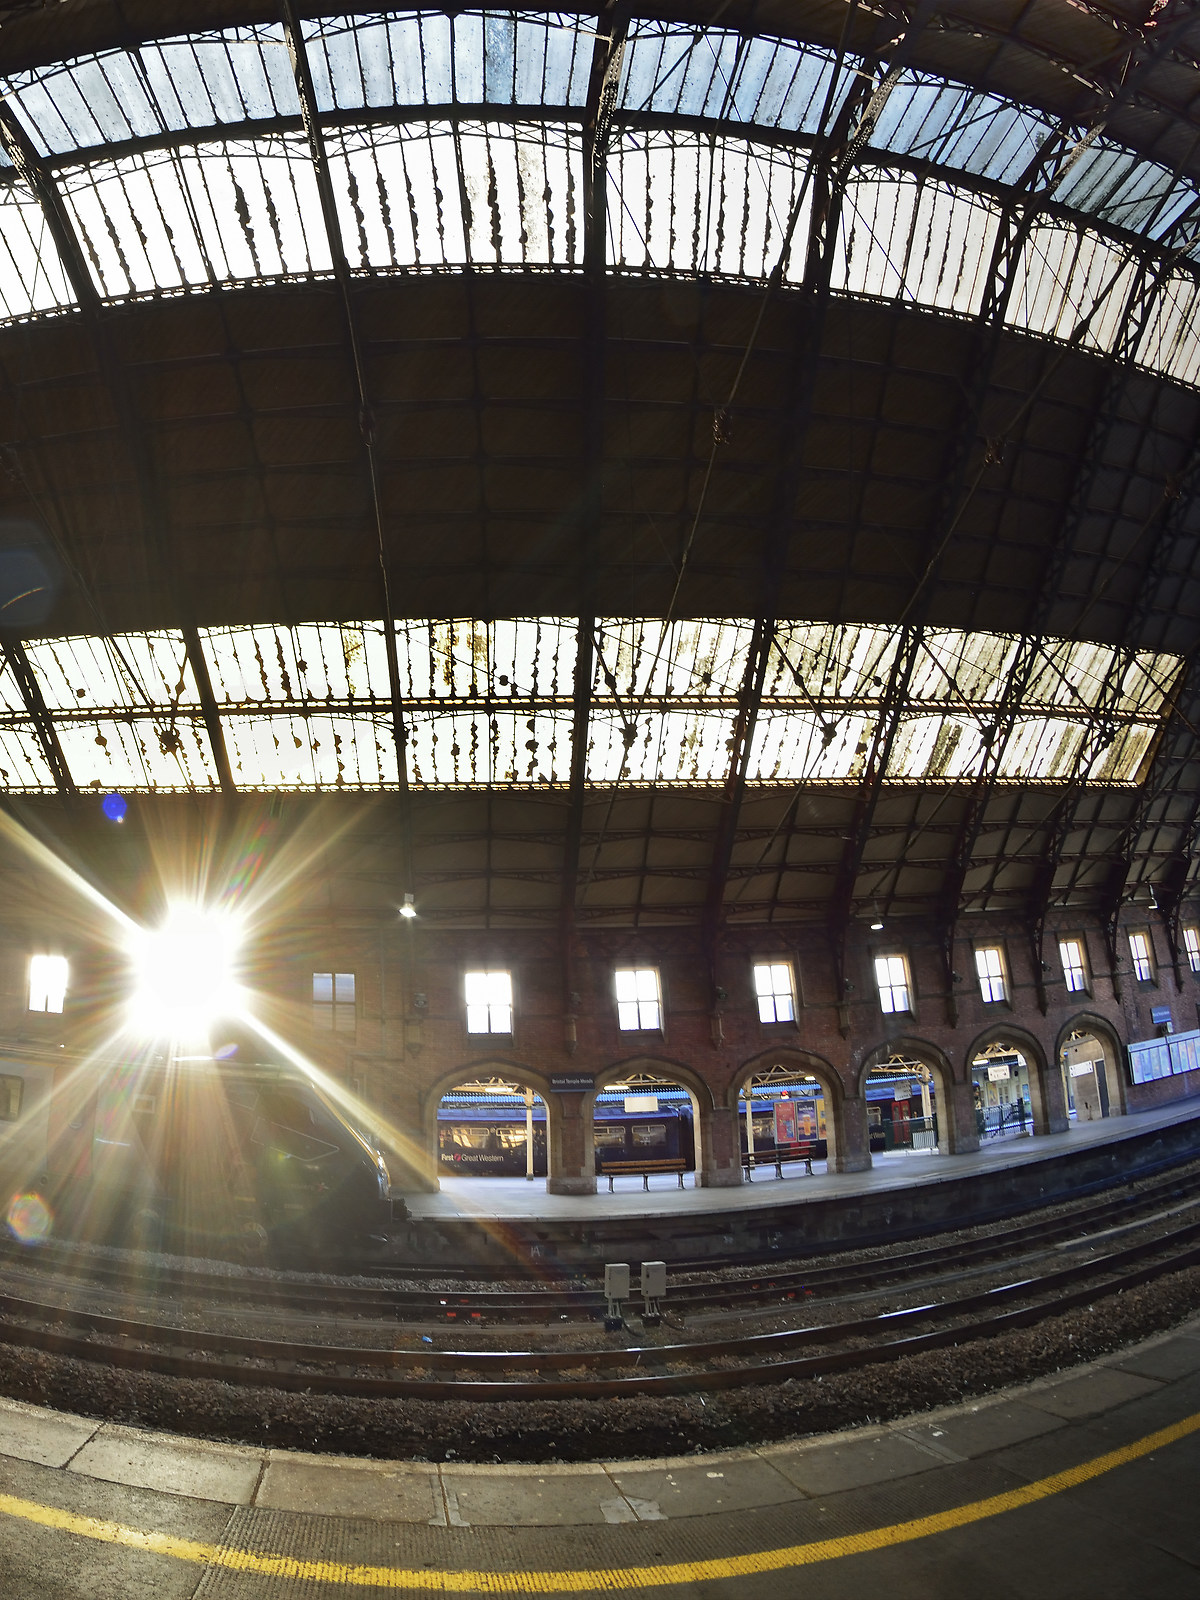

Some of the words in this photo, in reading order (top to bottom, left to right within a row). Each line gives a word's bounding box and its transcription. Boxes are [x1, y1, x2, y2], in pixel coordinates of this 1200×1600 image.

[441, 1153, 455, 1161] First
[461, 1153, 479, 1162] Great
[479, 1154, 505, 1162] Western
